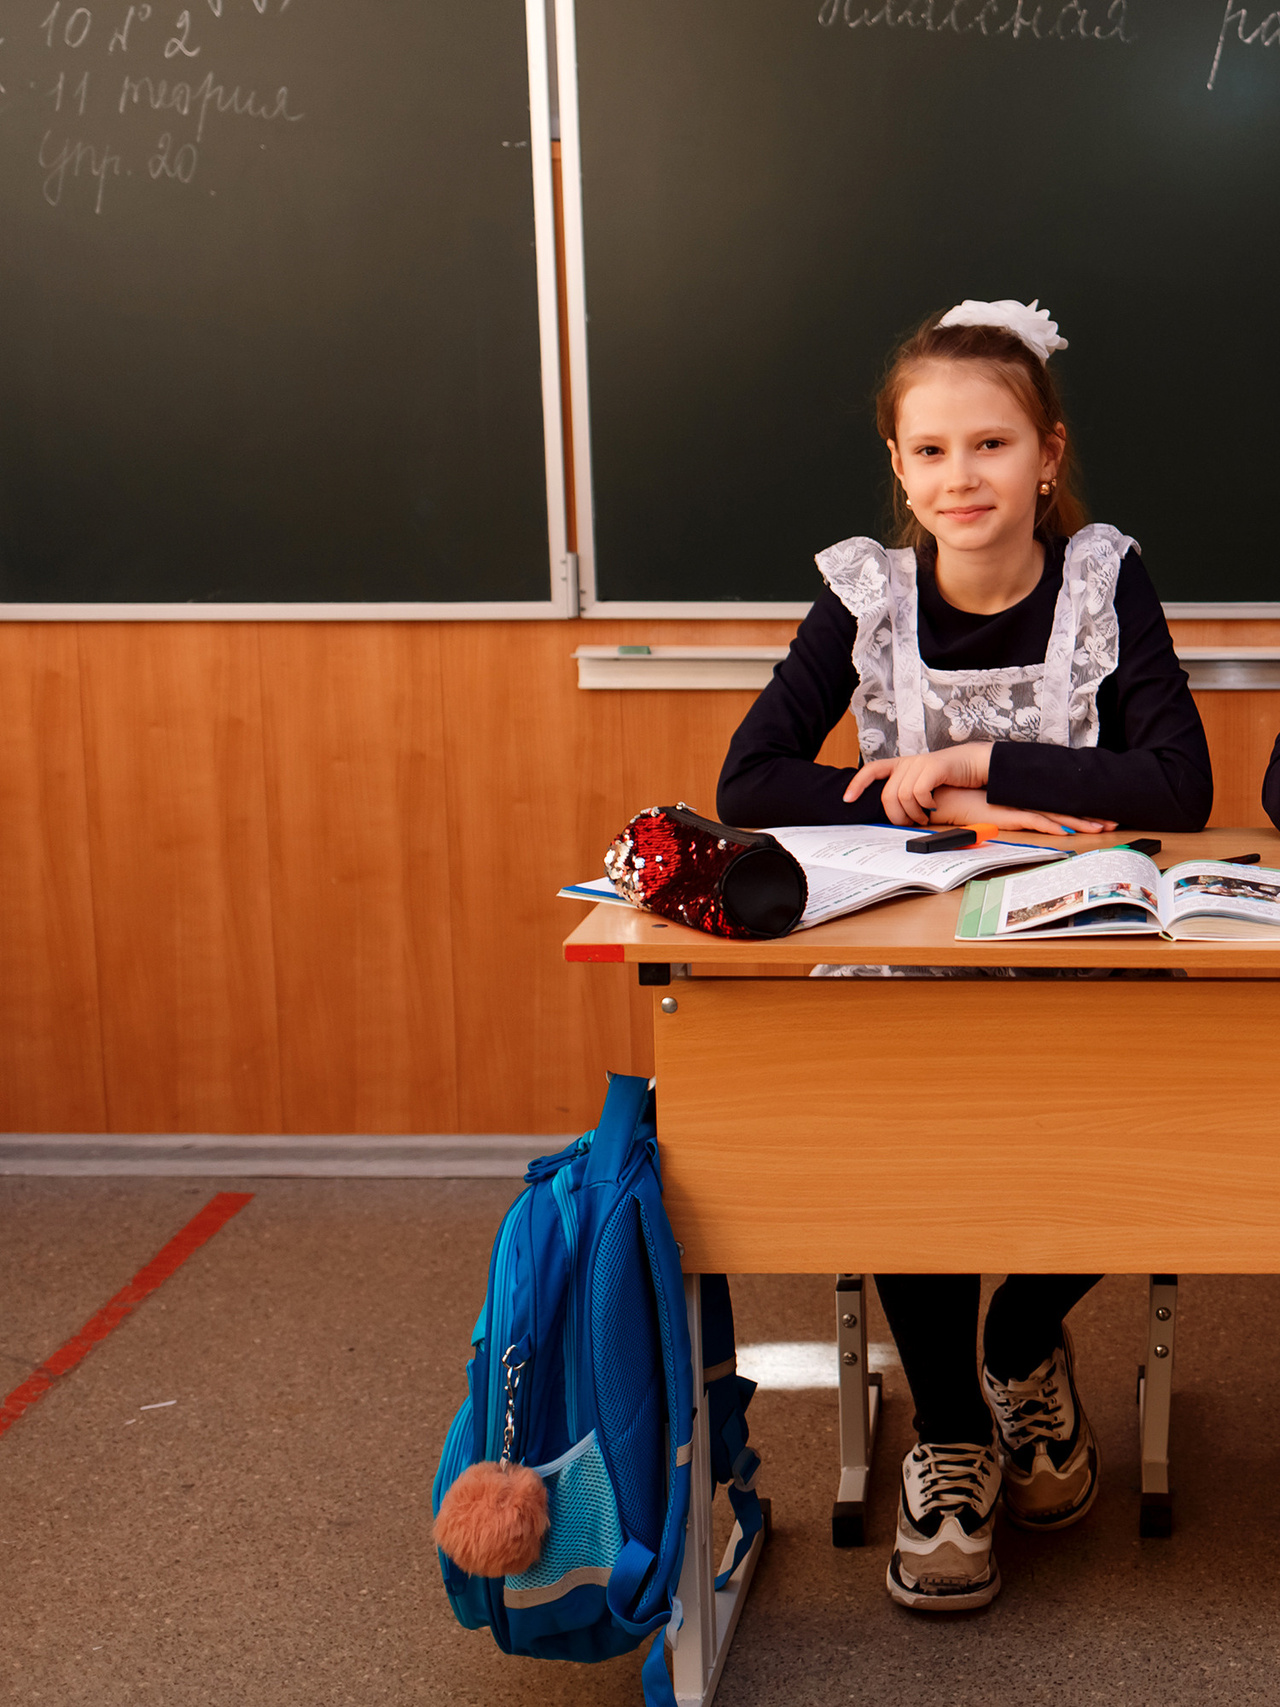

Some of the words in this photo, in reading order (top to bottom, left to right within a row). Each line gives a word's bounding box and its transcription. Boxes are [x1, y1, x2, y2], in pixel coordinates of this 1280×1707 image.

[40, 1, 92, 48] 10
[163, 9, 200, 59] 2
[50, 71, 89, 116] 11
[119, 70, 305, 143] теория
[149, 132, 198, 184] 20
